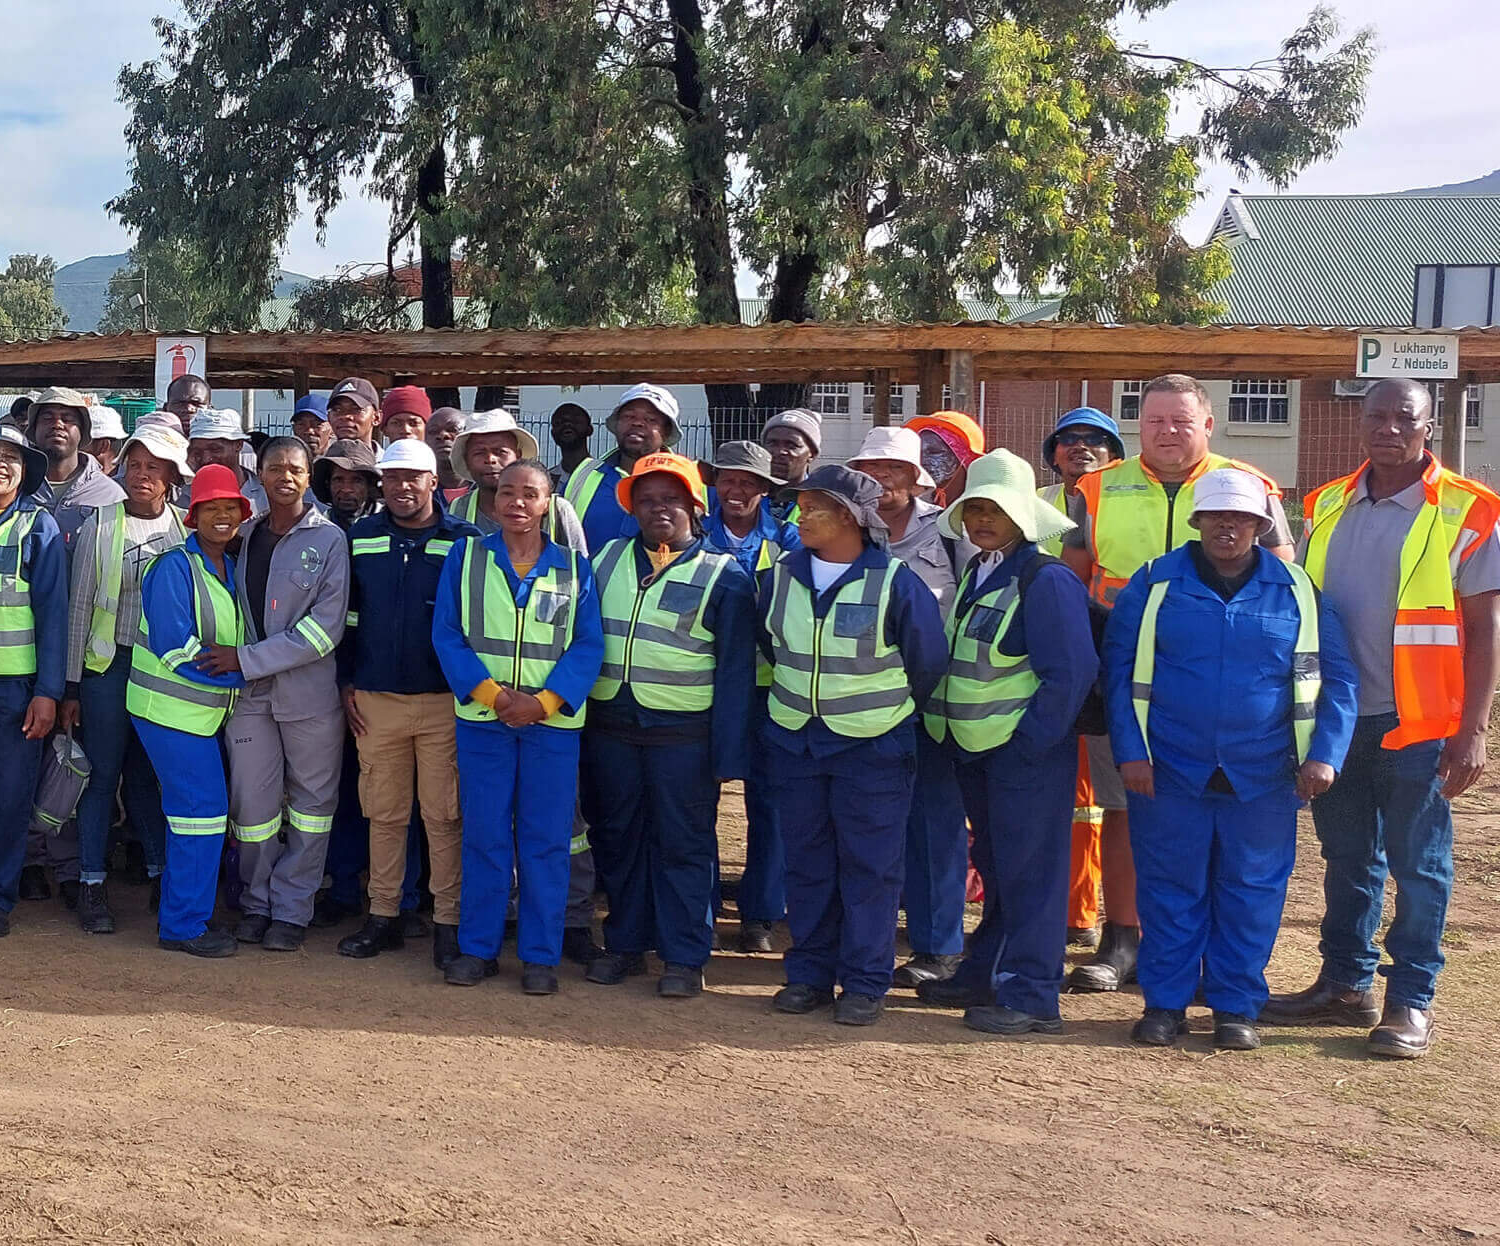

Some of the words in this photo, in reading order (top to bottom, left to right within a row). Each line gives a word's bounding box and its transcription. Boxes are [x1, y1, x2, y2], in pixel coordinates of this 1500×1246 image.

[1362, 338, 1381, 373] P
[1393, 342, 1446, 356] Lukhanyo
[1391, 358, 1400, 369] Z.
[1404, 358, 1448, 369] Ndubela
